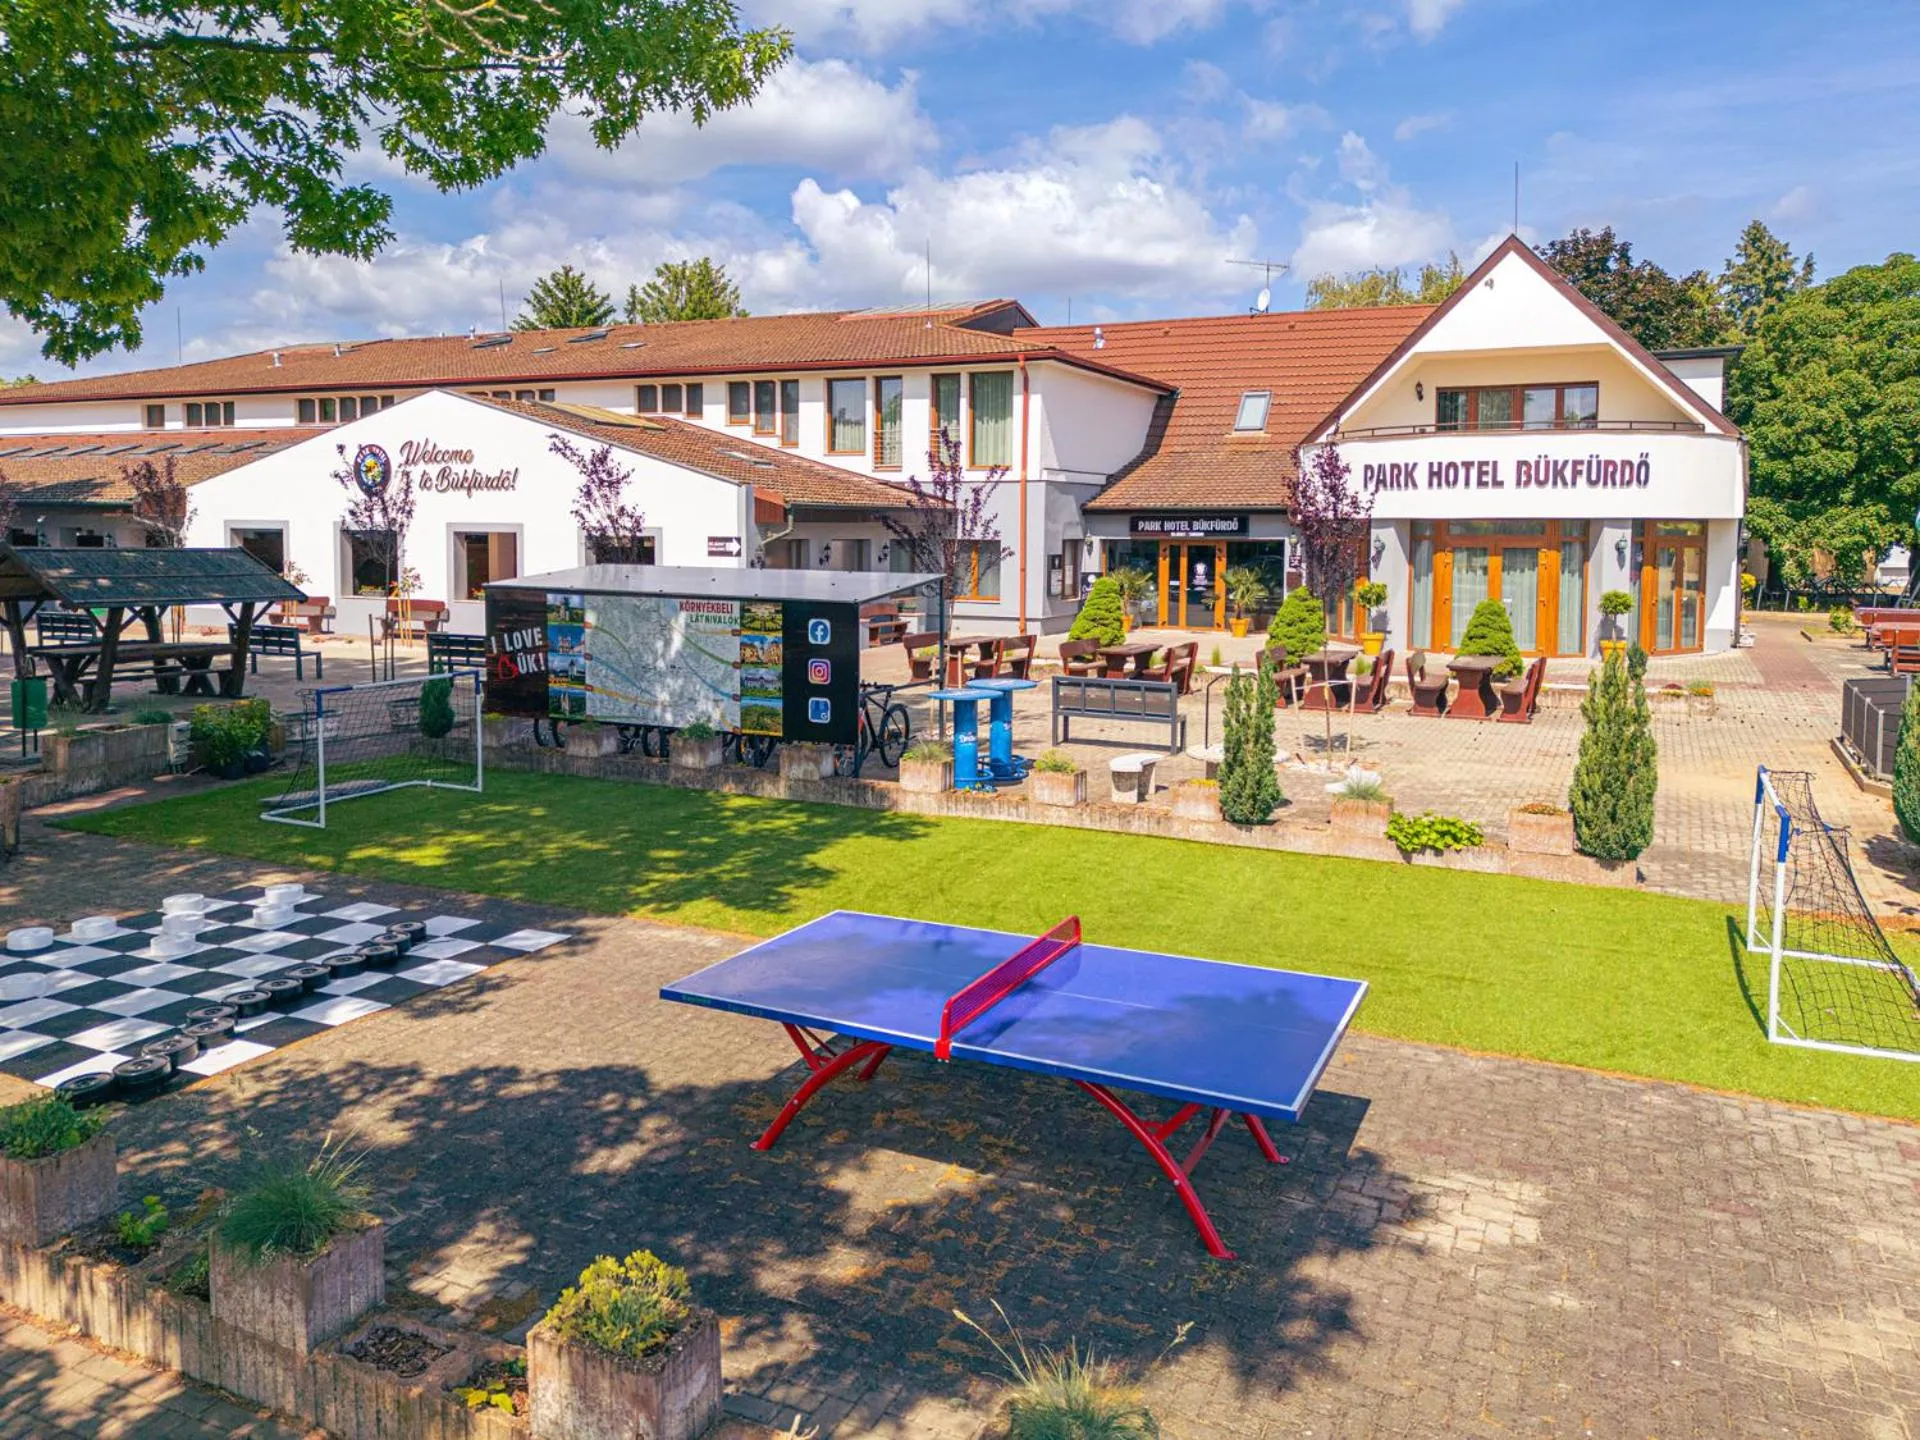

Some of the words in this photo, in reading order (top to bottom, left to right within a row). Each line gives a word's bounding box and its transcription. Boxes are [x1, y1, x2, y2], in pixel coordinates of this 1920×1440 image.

[400, 438, 474, 467] Welcome
[420, 469, 433, 491] to
[1363, 463, 1418, 491] PARK
[1428, 461, 1504, 490] HOTEL
[1515, 453, 1650, 490] BÜKFÜRDŐ
[1138, 521, 1161, 530] PARK
[1164, 521, 1190, 530] HOTEL
[1193, 518, 1239, 530] BÜKFÜRDŐ
[490, 635, 497, 654] I
[503, 627, 543, 652] LOVE
